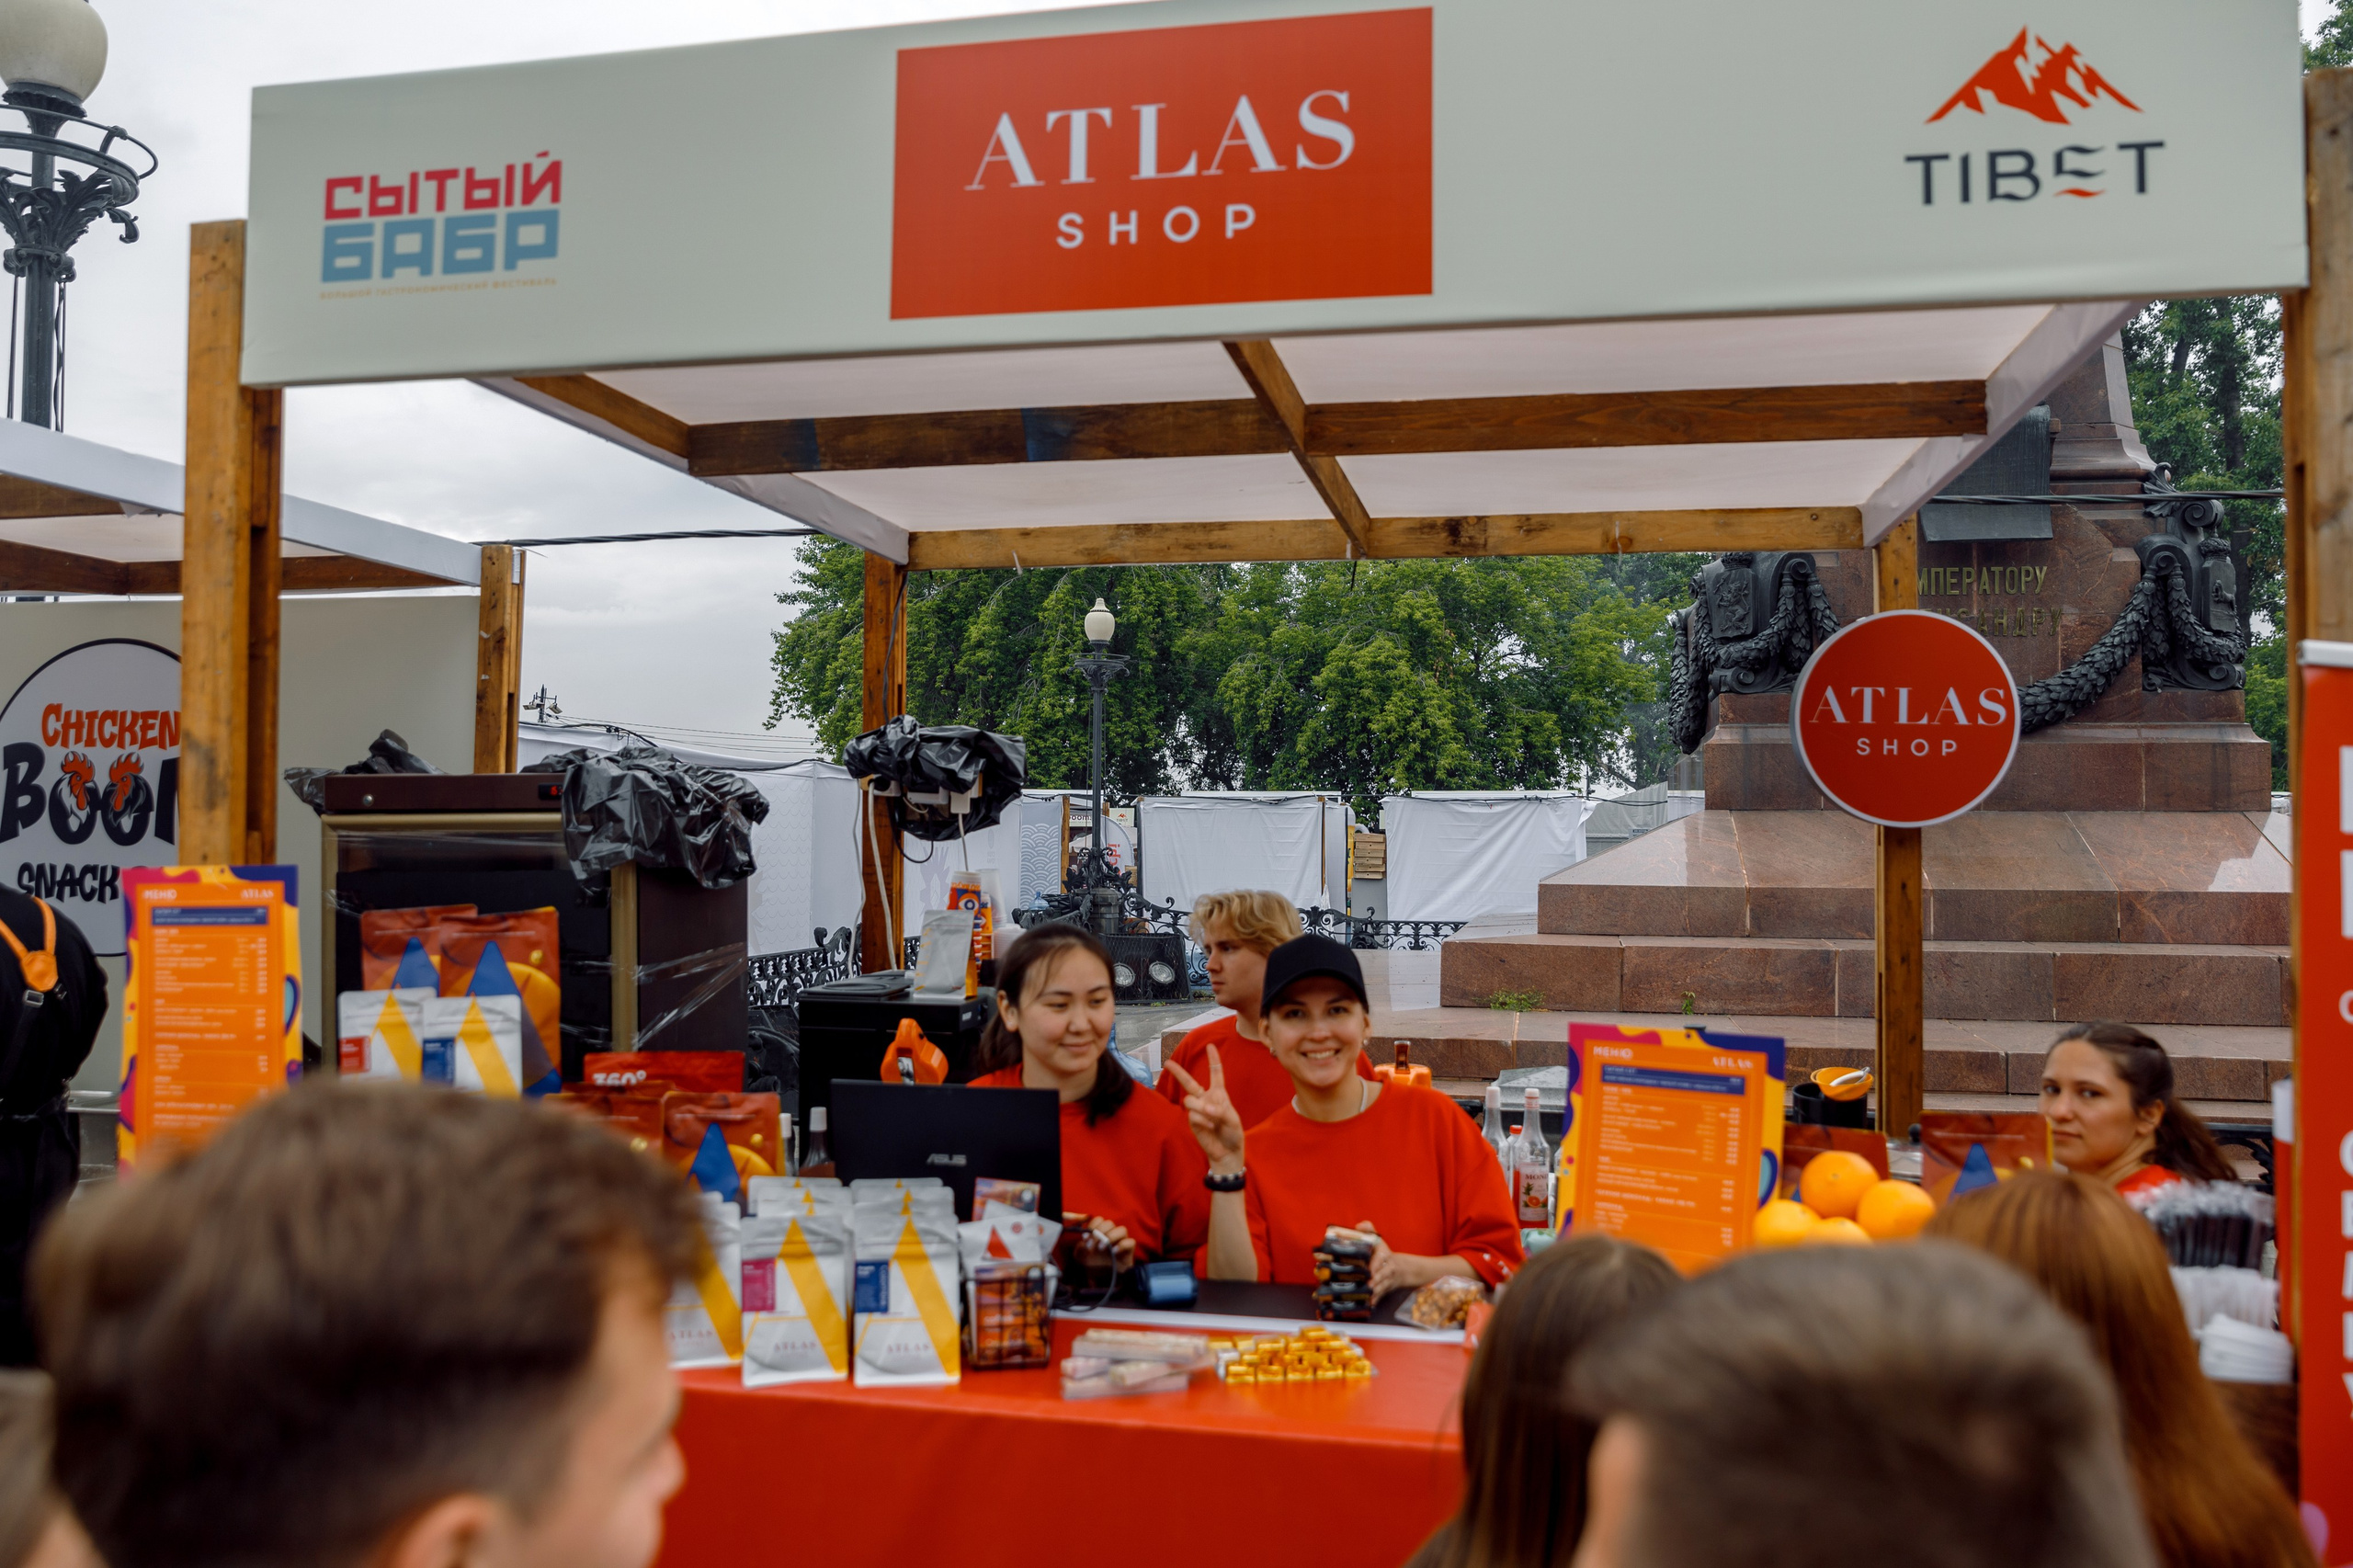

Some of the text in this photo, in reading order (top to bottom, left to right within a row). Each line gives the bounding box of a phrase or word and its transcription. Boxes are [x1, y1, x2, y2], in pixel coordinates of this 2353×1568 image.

[963, 90, 1356, 191] ATLAS
[324, 151, 563, 221] СЫТЫЙ
[1904, 141, 2165, 206] TIBET
[320, 209, 560, 283] БАБР
[1056, 203, 1256, 249] SHOP
[41, 702, 181, 750] CHICKEN
[1808, 685, 2006, 726] ATLAS
[1856, 737, 1958, 756] SHOP
[17, 862, 119, 903] SNACK
[142, 889, 177, 900] МЕНЮ
[240, 888, 274, 899] ATLAS
[1593, 1046, 1633, 1060] МЕНЮ
[926, 1153, 967, 1165] ASUS
